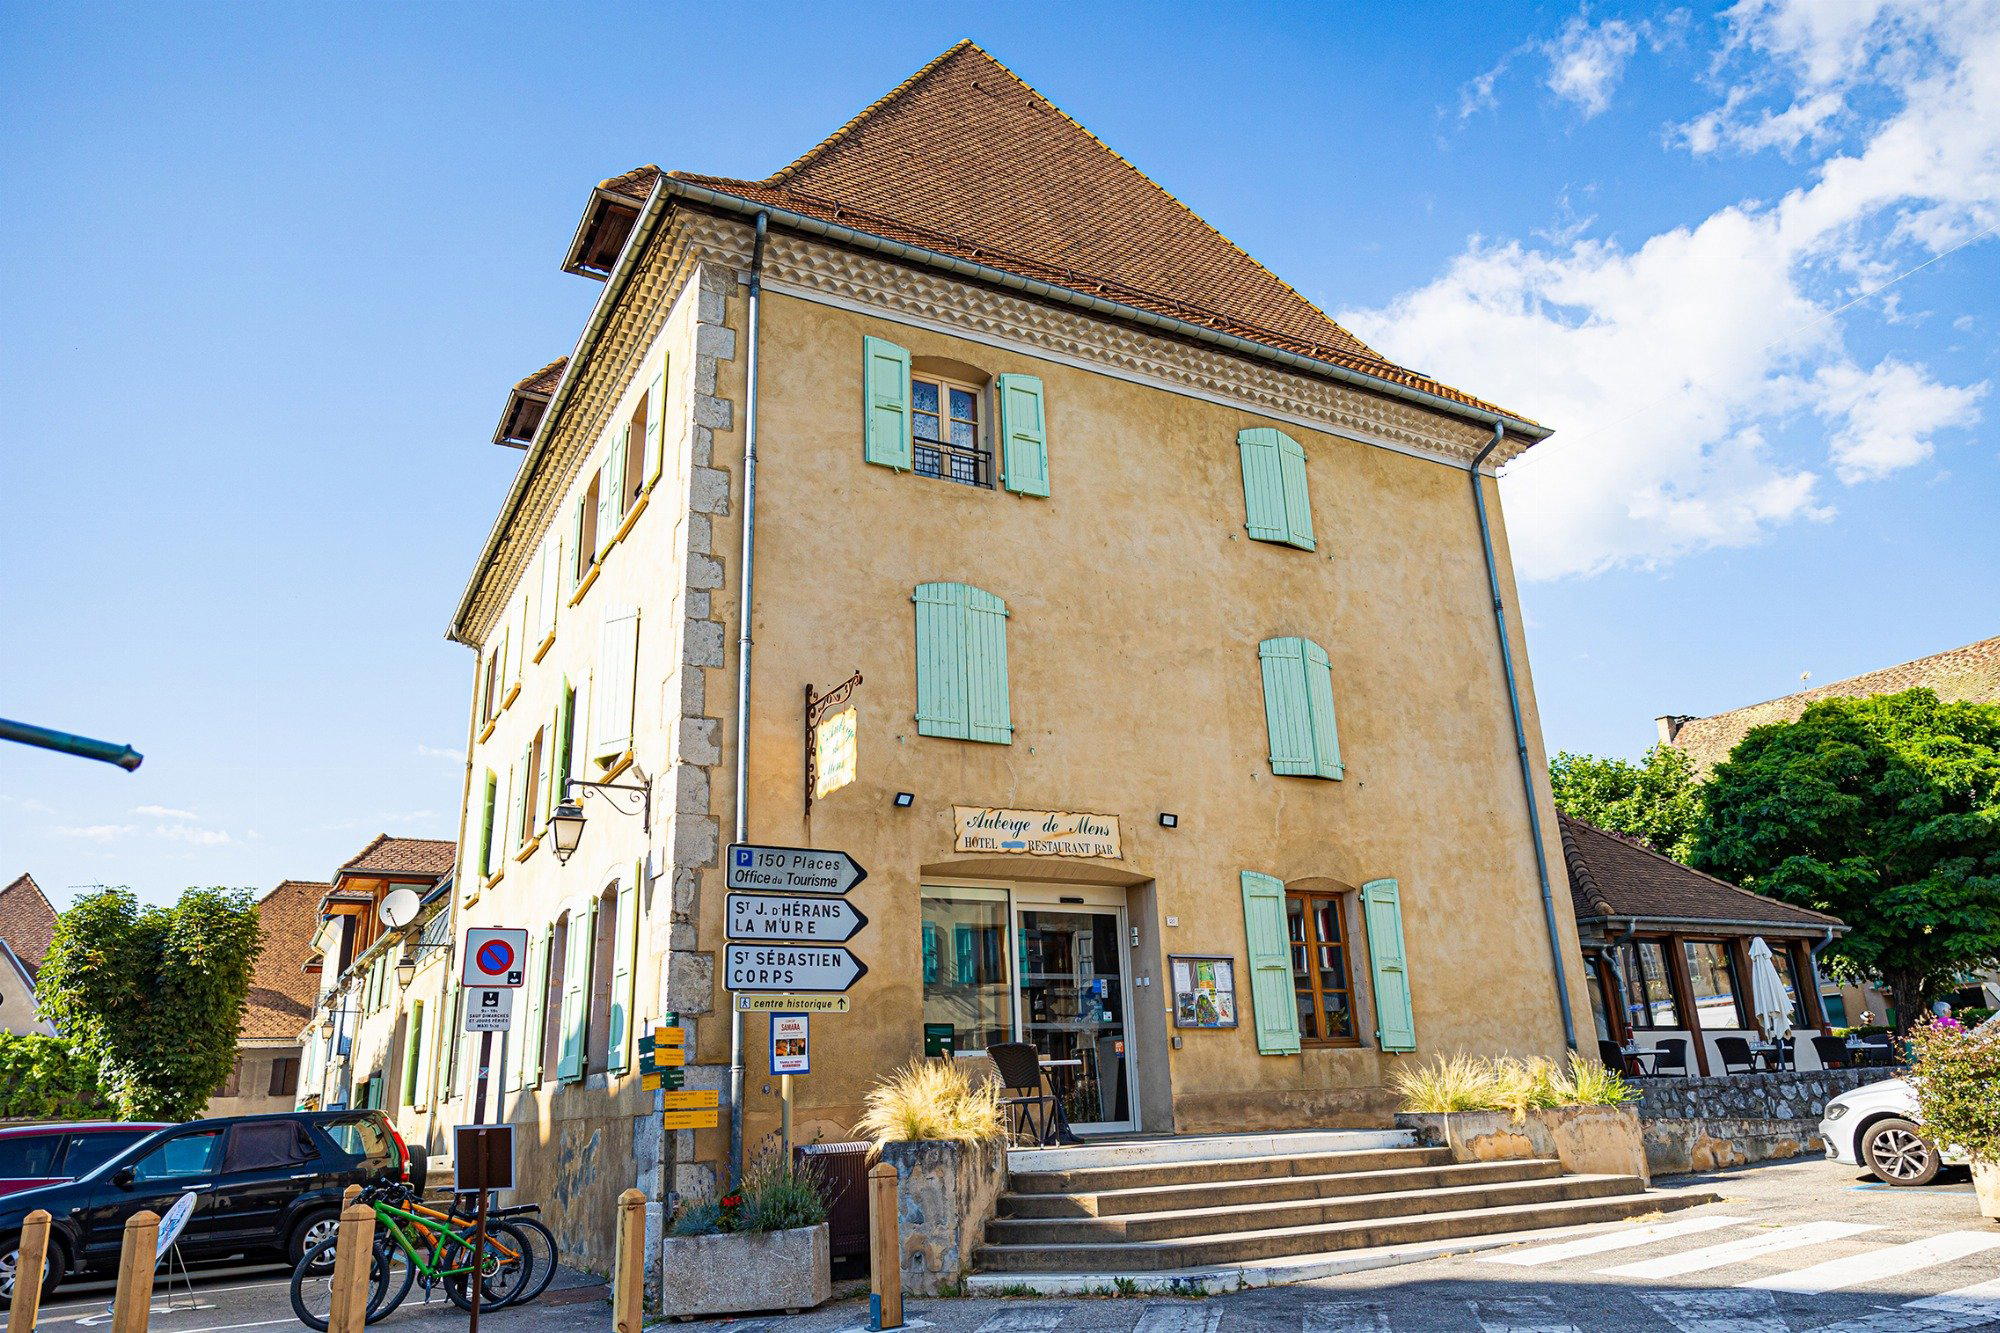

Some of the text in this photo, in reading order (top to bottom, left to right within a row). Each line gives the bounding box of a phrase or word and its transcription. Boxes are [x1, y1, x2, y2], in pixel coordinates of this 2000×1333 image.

[966, 810, 1110, 838] Auberge de Mens
[1028, 840, 1090, 854] RESTAURANT
[1094, 844, 1114, 855] BAR
[758, 854, 785, 867] 150
[793, 856, 840, 870] Places
[735, 870, 837, 887] Office du Tourisme
[756, 902, 767, 915] J.
[735, 919, 754, 932] LA
[756, 949, 841, 967] SÉBASTIEN
[734, 970, 794, 983] CORPS
[754, 999, 832, 1010] centre historique
